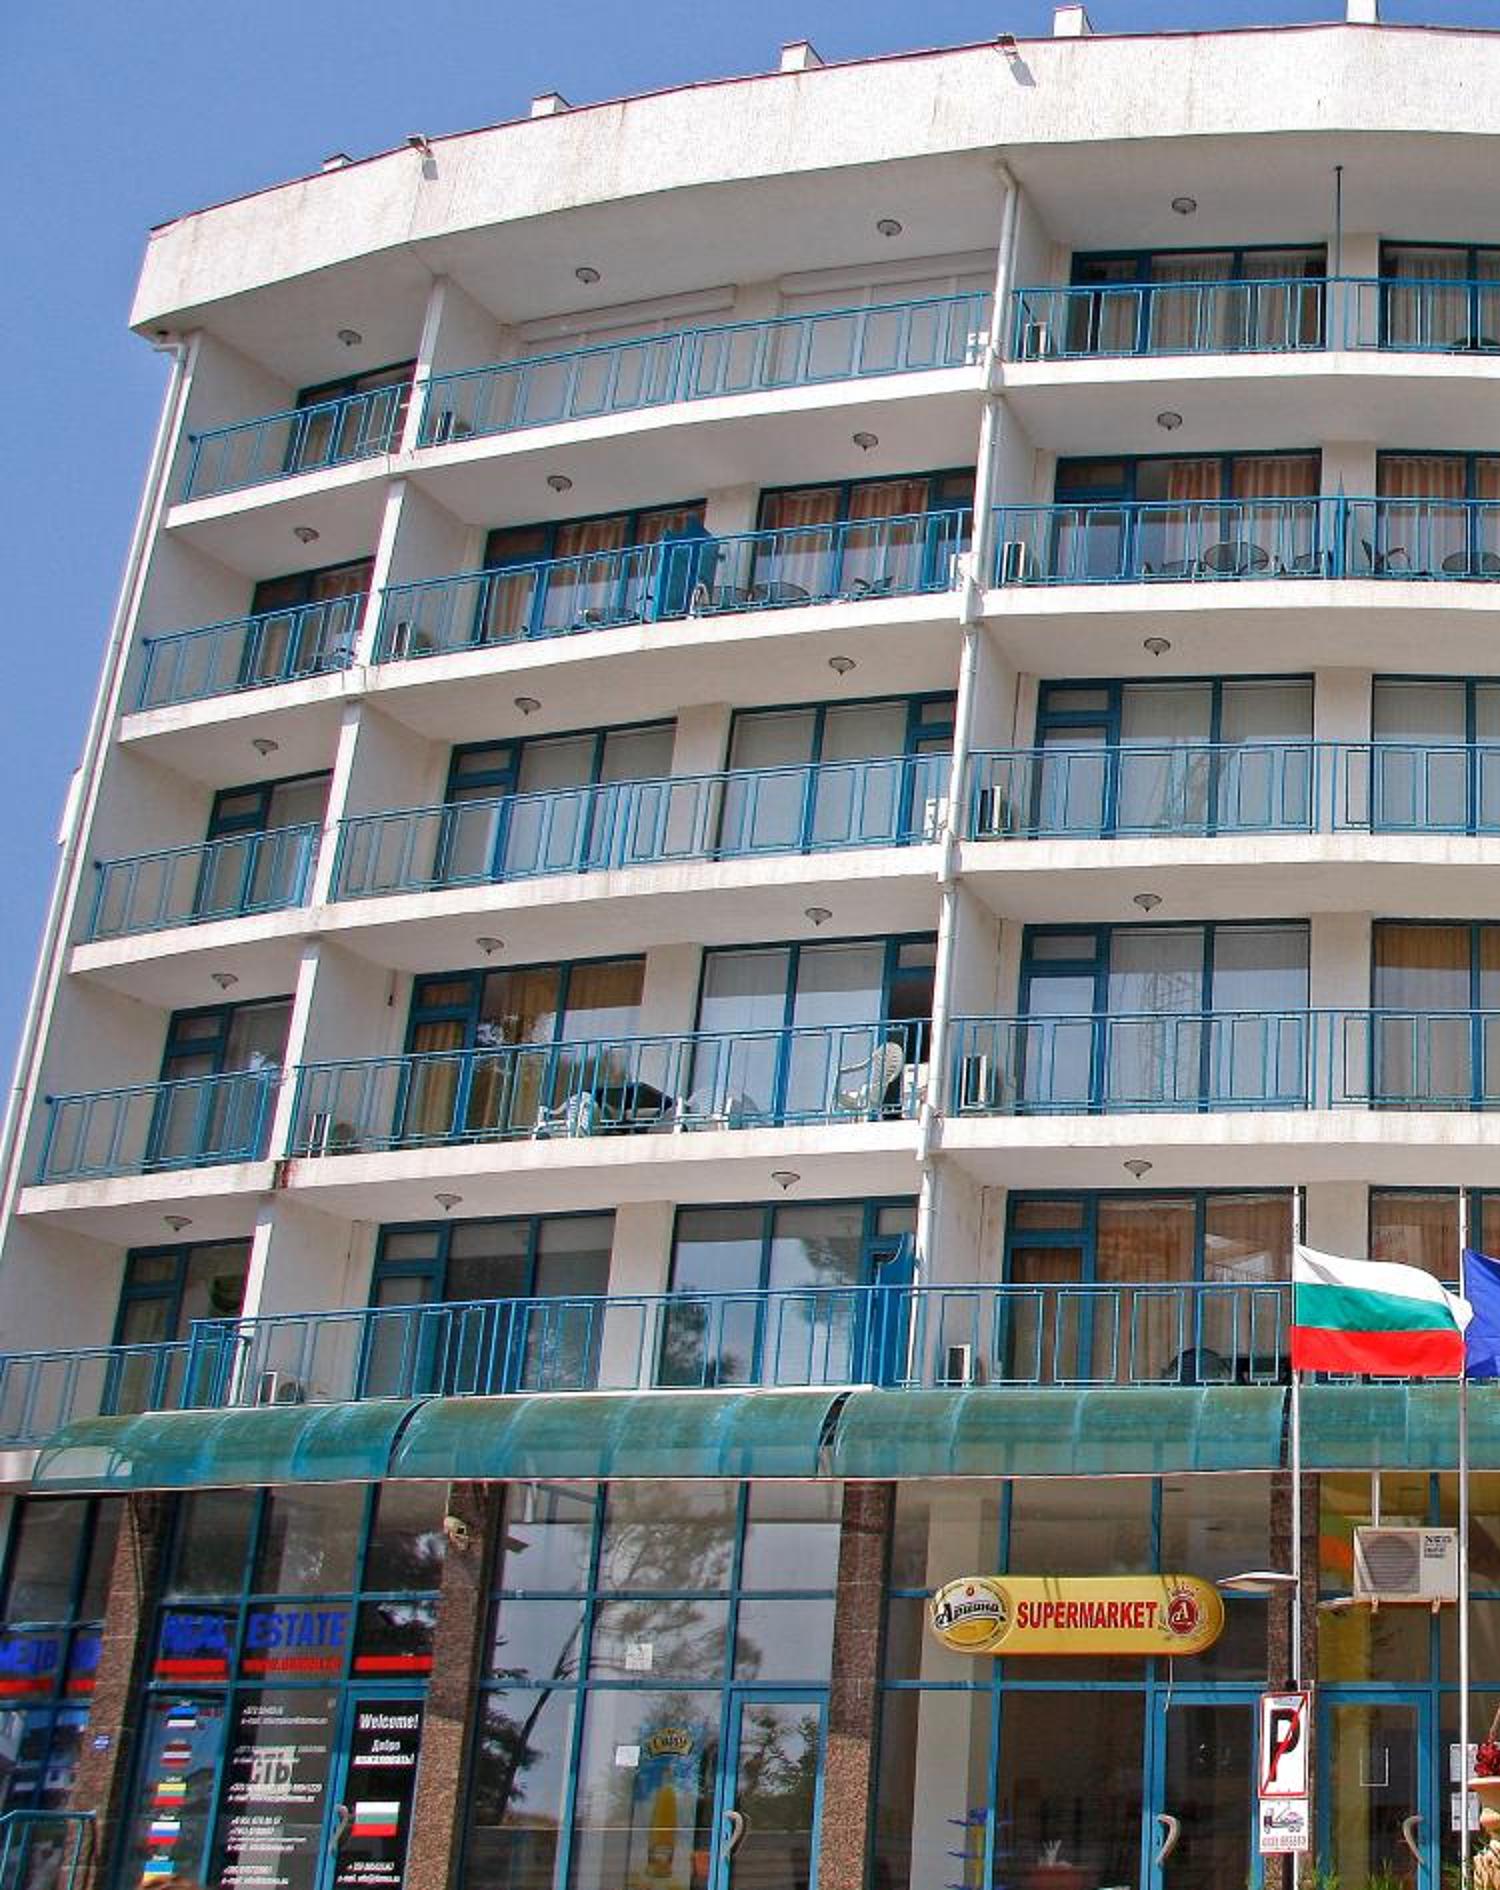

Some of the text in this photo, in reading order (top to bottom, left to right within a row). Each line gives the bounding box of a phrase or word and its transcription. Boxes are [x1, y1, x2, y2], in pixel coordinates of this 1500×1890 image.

[1017, 1601, 1157, 1629] SUPERMARKET
[247, 1611, 350, 1648] ESTATE
[359, 1713, 419, 1729] Welcome!
